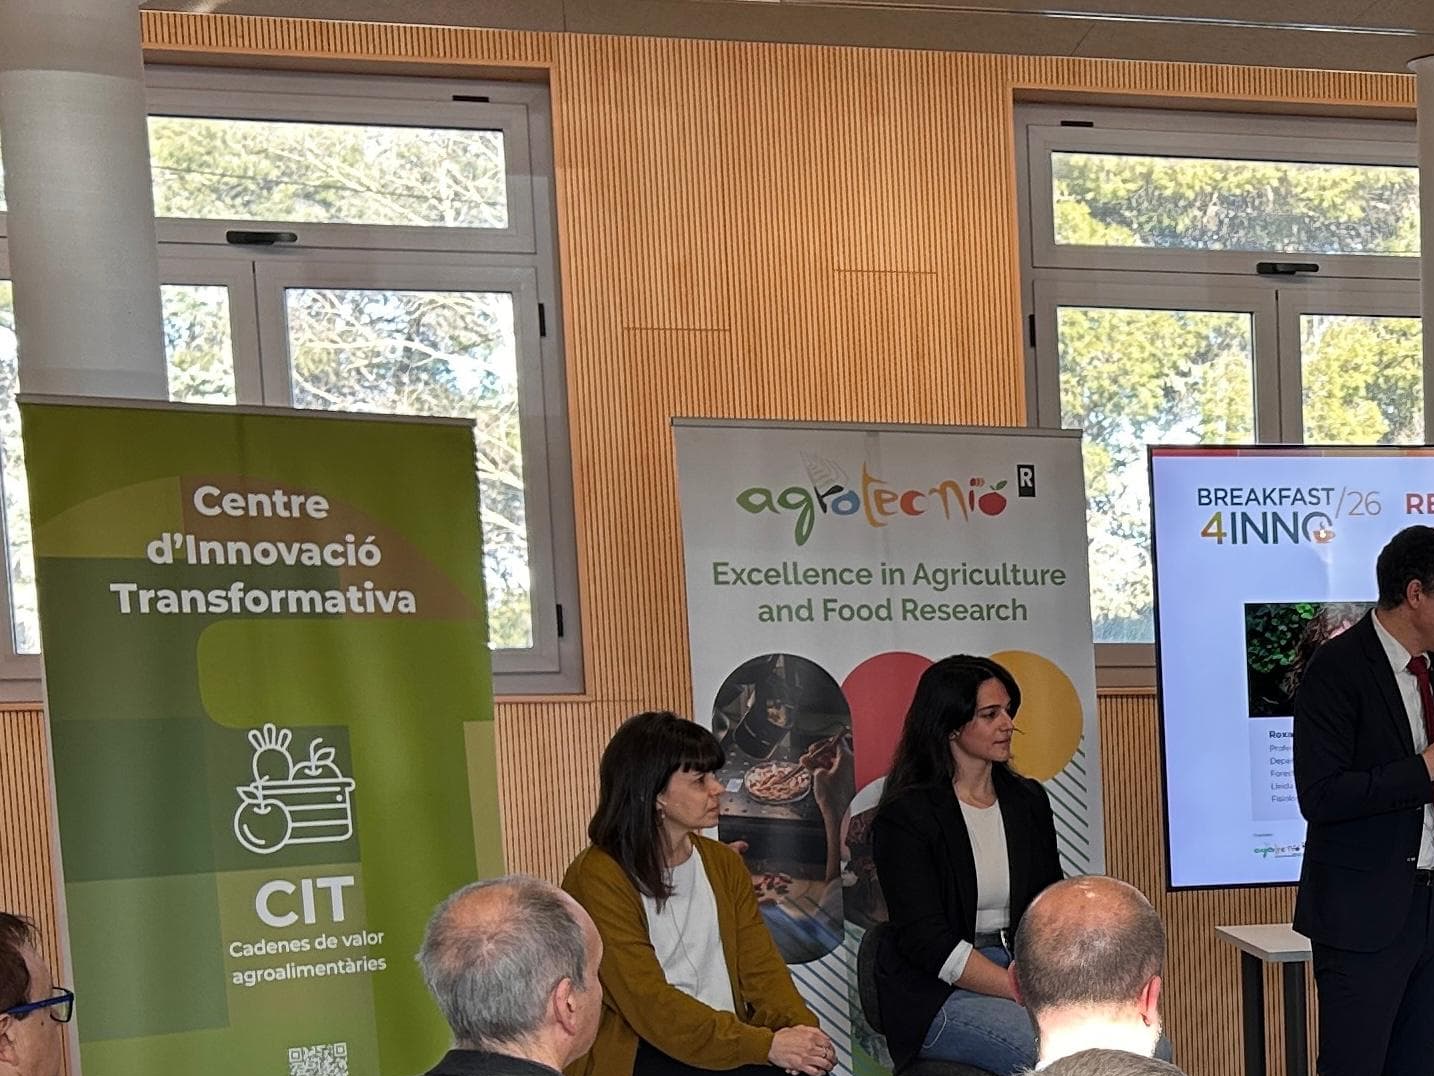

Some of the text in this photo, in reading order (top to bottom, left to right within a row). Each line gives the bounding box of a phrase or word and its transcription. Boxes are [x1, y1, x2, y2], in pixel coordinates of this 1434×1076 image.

[194, 485, 329, 519] Centre
[1197, 487, 1335, 508] BREAKFAST
[147, 533, 381, 566] d'Innovació
[713, 562, 1066, 591] Excellence in Agriculture
[110, 582, 416, 615] Transformativa
[758, 599, 1027, 622] and Food Research
[254, 876, 355, 927] CIT
[229, 931, 385, 958] Cadenes de valor
[232, 954, 387, 987] agroalimentàries
